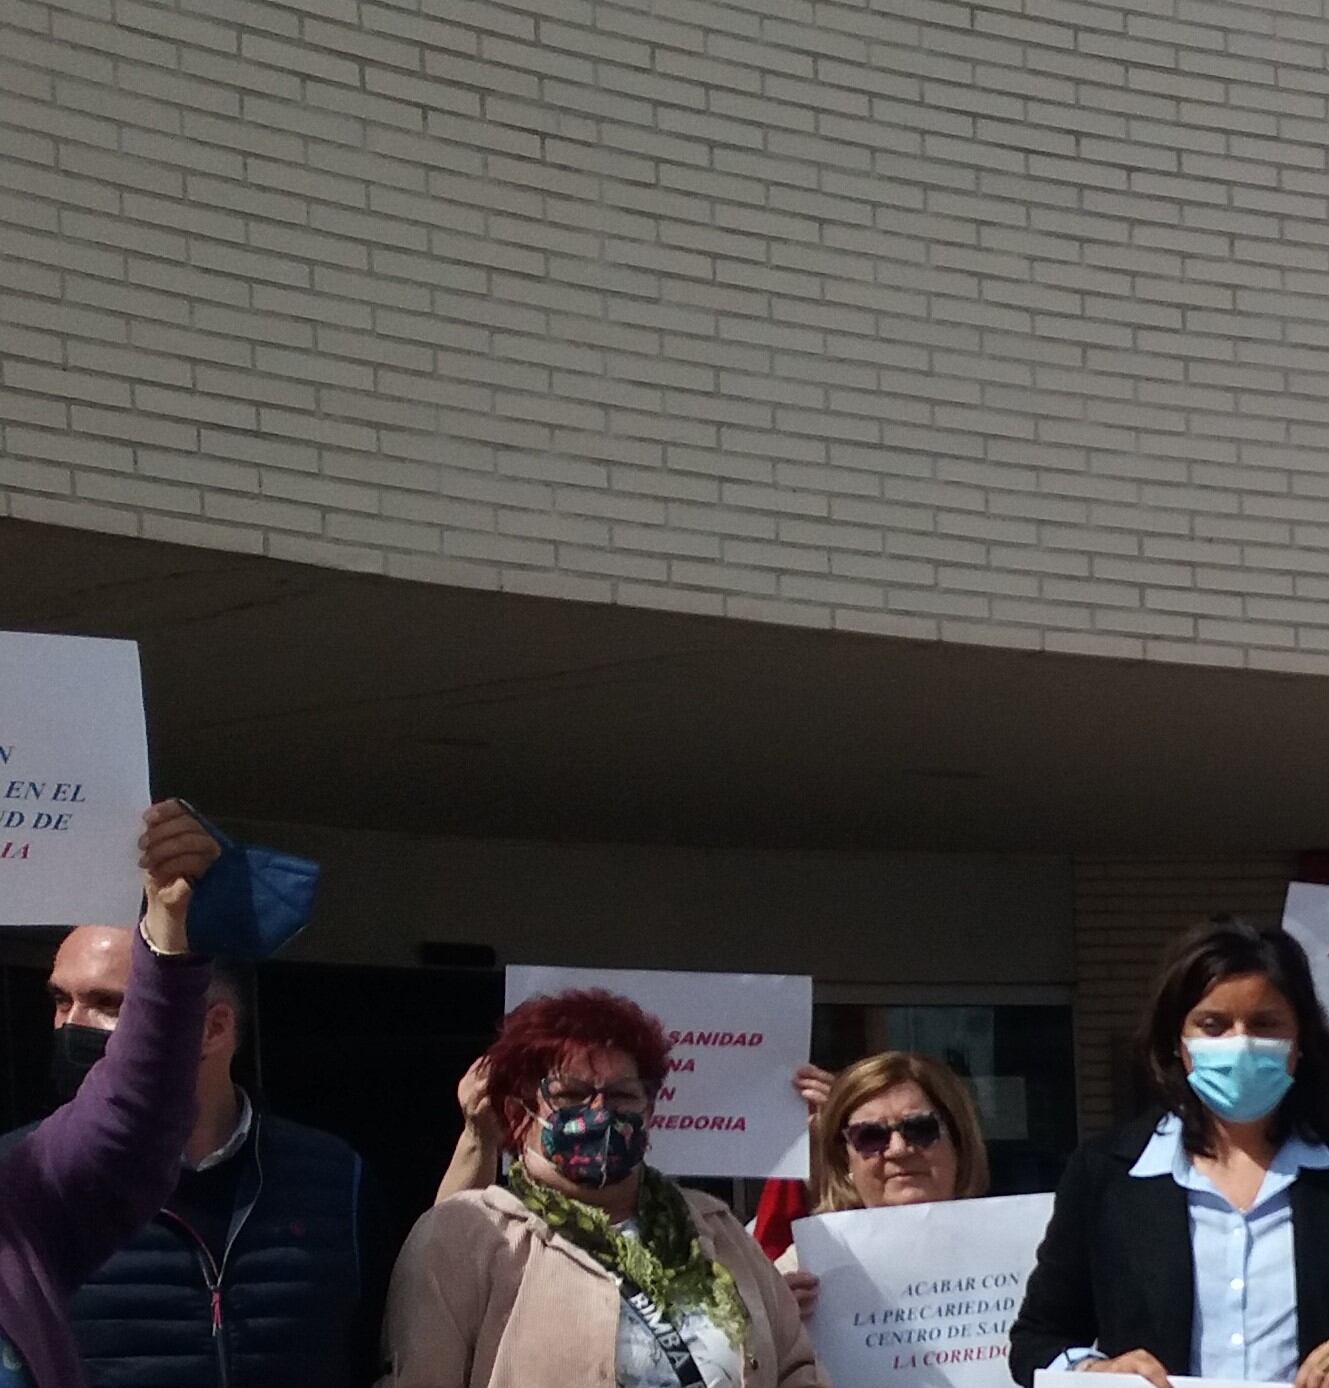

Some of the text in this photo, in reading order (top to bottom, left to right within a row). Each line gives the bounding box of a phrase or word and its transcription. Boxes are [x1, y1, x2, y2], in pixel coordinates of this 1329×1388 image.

[5, 781, 86, 802] EN EL
[32, 812, 73, 831] DE
[667, 1030, 763, 1047] SANIDAD
[650, 1114, 746, 1131] REDORIA
[902, 1272, 1022, 1297] ACABAR CON
[853, 1297, 1016, 1326] LA PRECARIEDAD
[630, 1291, 691, 1370] BIMBA
[865, 1320, 1009, 1348] CENTRO DE SAL
[893, 1345, 1009, 1369] LA CORREDO
